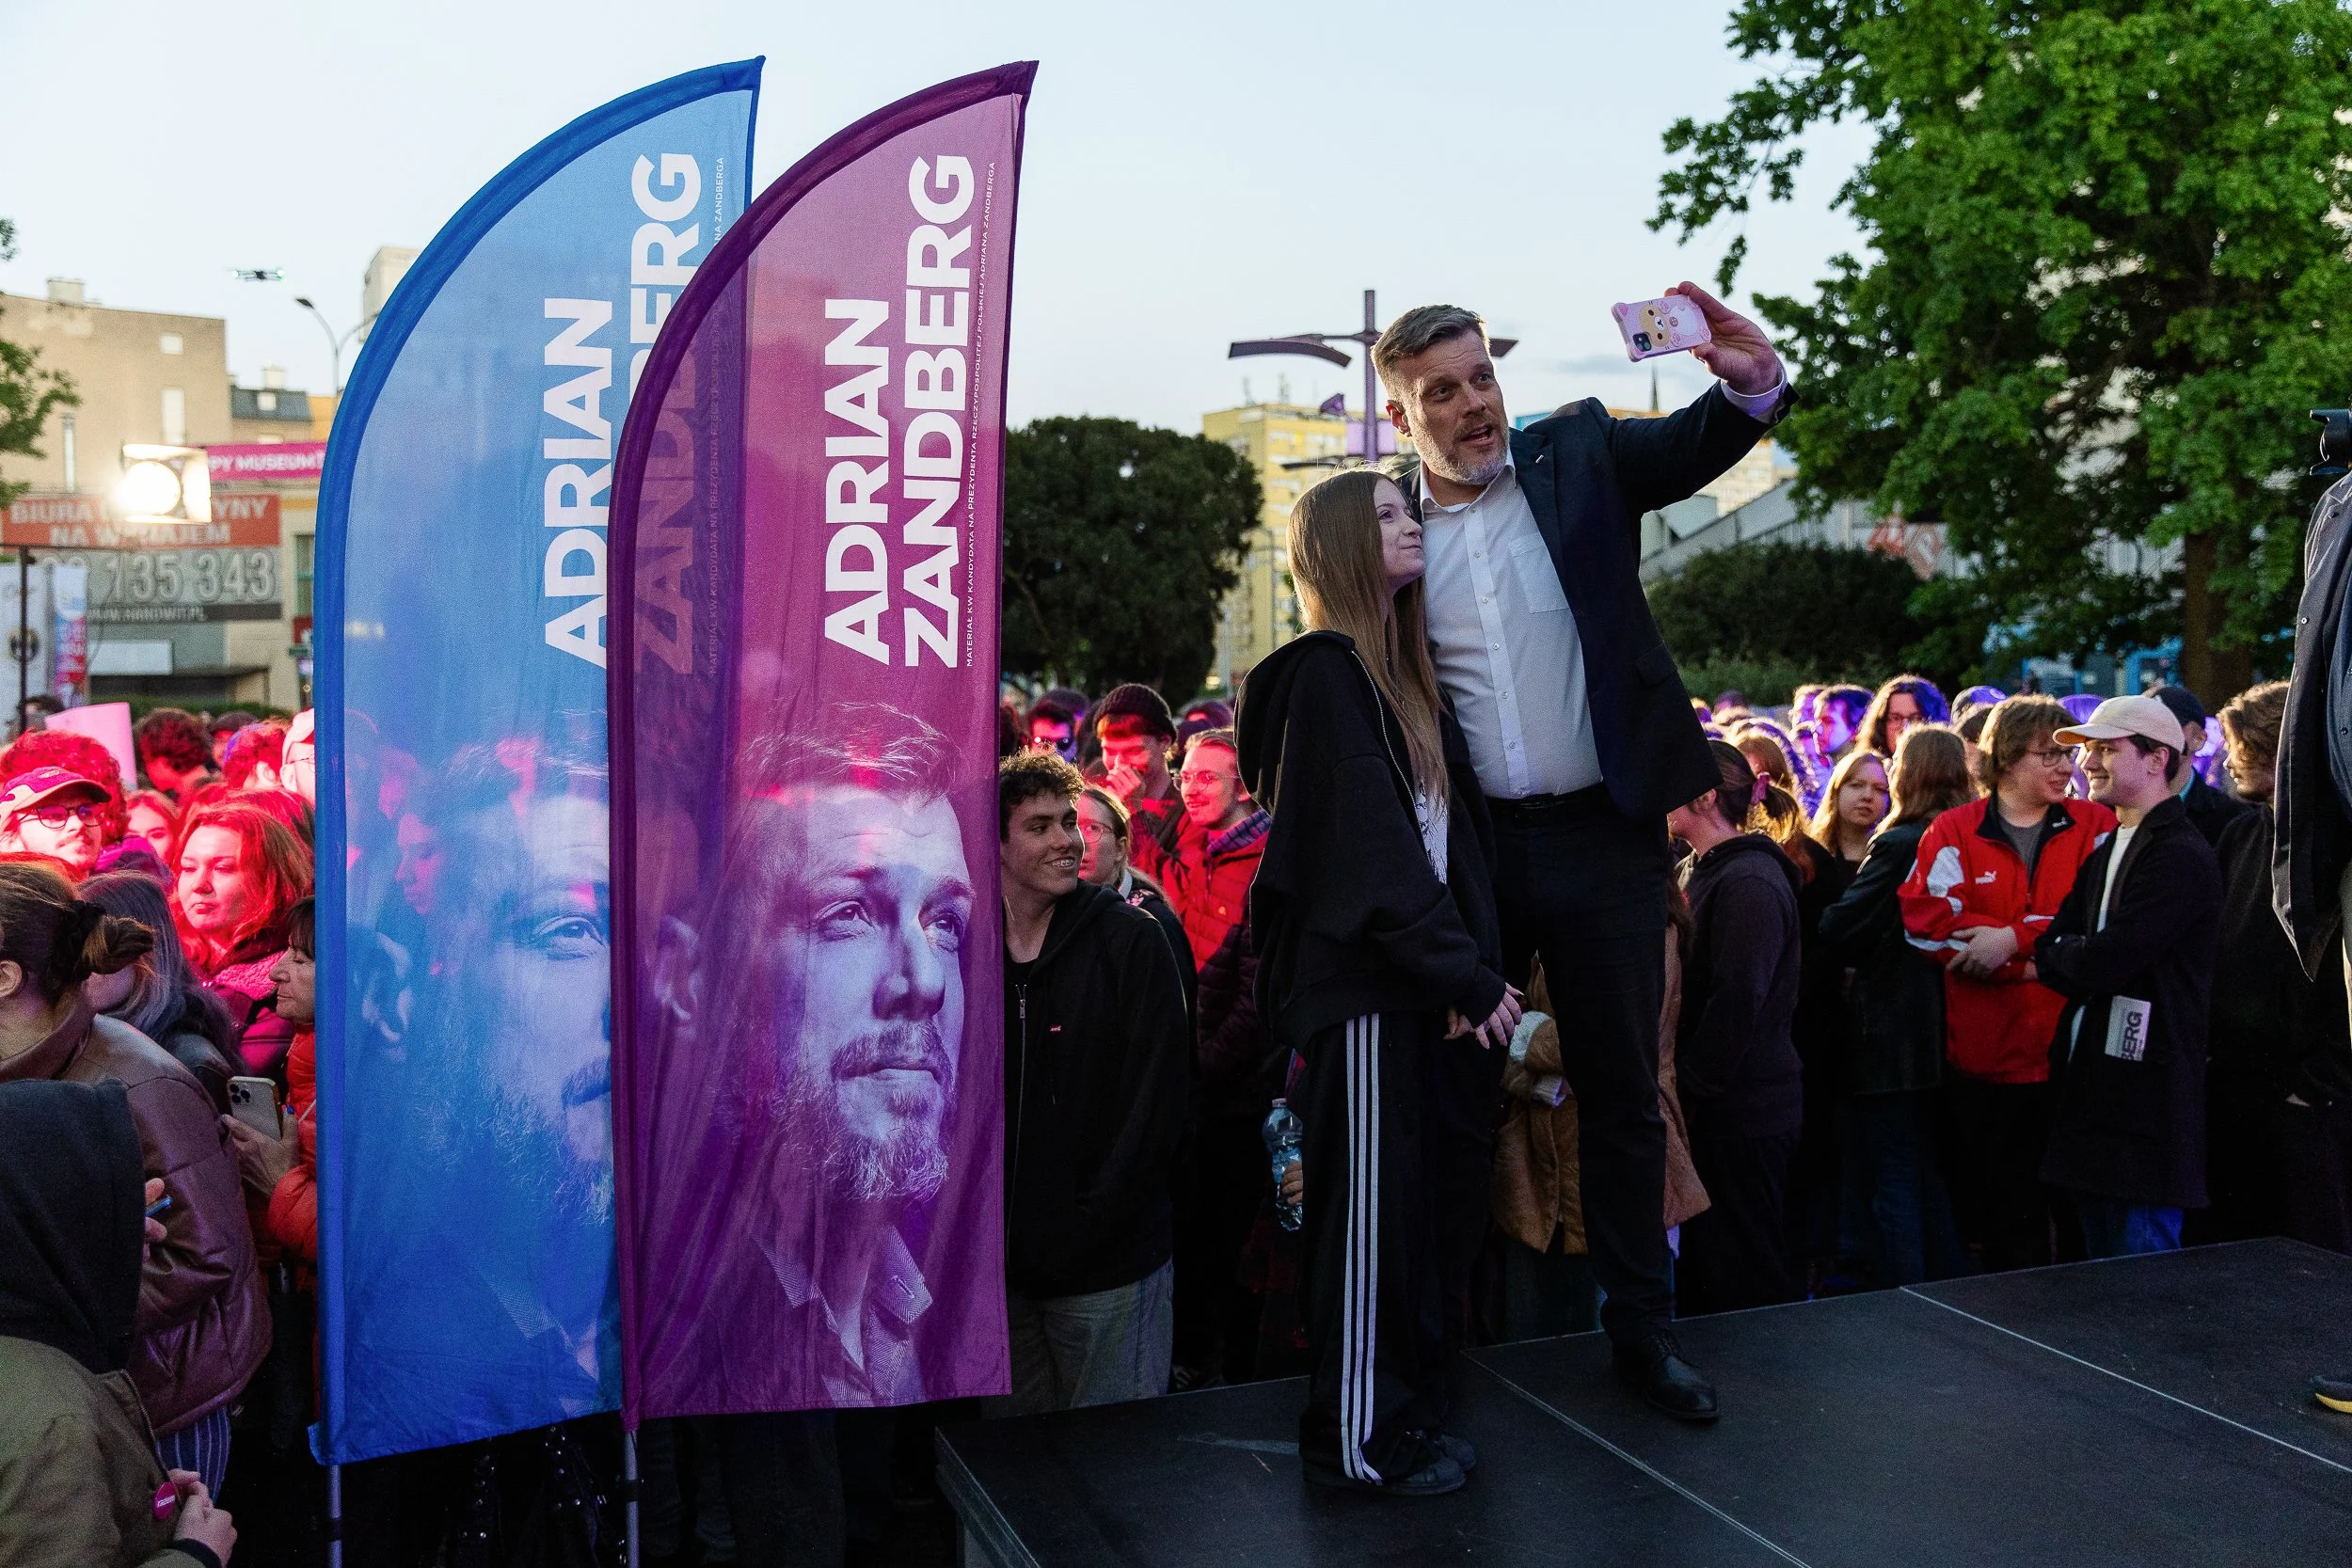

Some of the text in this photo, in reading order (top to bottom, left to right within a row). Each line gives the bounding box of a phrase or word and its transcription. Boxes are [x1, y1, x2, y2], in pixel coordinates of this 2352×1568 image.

[714, 157, 724, 223] ZANDBERGA
[983, 162, 995, 229] ZANDBERGA
[979, 231, 989, 279] ADRIANA
[977, 282, 986, 332] POLSKIEJ
[903, 154, 975, 668] ZANDBERG
[972, 335, 983, 439] RZECZYPOSPOLITEJ
[544, 298, 612, 667] ADRIAN
[824, 298, 890, 666] ADRIAN
[968, 442, 977, 509] PREZYDENTA
[967, 513, 975, 528] NA
[197, 551, 275, 601] 343
[967, 596, 974, 613] KW
